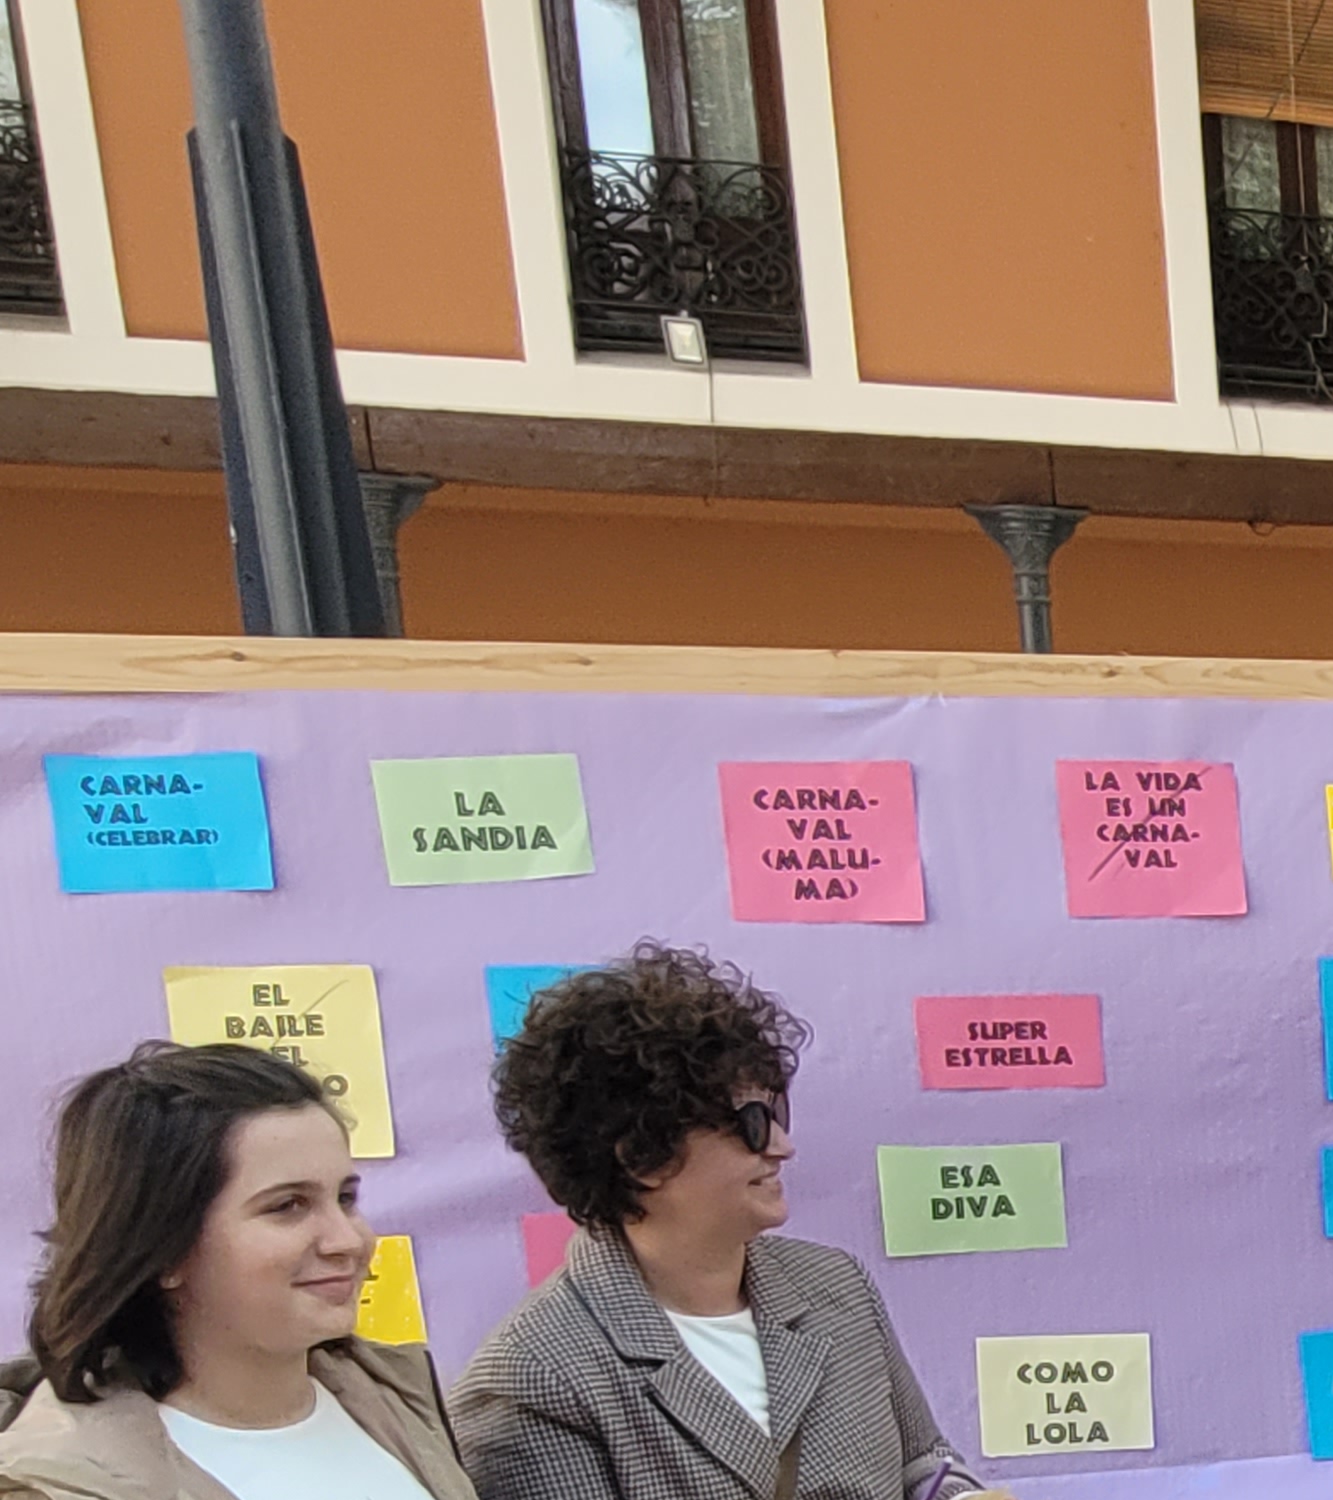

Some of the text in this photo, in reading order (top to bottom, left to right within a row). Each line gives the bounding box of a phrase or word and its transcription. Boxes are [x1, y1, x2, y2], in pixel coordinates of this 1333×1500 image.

[81, 775, 204, 797] CARNA-
[1085, 771, 1203, 791] LA VIDA
[455, 791, 505, 817] LA
[753, 788, 880, 811] CARNA-
[1106, 797, 1186, 817] ES UN
[86, 803, 148, 824] VAL
[87, 830, 219, 847] (CELEBRAR)
[413, 824, 558, 853] SANDIA
[787, 819, 852, 840] VAL
[1096, 824, 1200, 843] CARNA-
[763, 849, 881, 871] (MALU-
[1124, 850, 1177, 868] VAL
[795, 879, 858, 900] MA)
[253, 984, 290, 1007] EL
[226, 1014, 325, 1039] BAILE
[968, 1021, 1048, 1042] SUPER
[270, 1045, 309, 1068] EL
[944, 1047, 1073, 1067] ESTRELLA
[940, 1164, 1001, 1189] ESA
[931, 1194, 1016, 1220] DIVA
[1016, 1359, 1115, 1387] COMO
[1046, 1392, 1088, 1416] LA
[1026, 1420, 1110, 1446] LOLA
